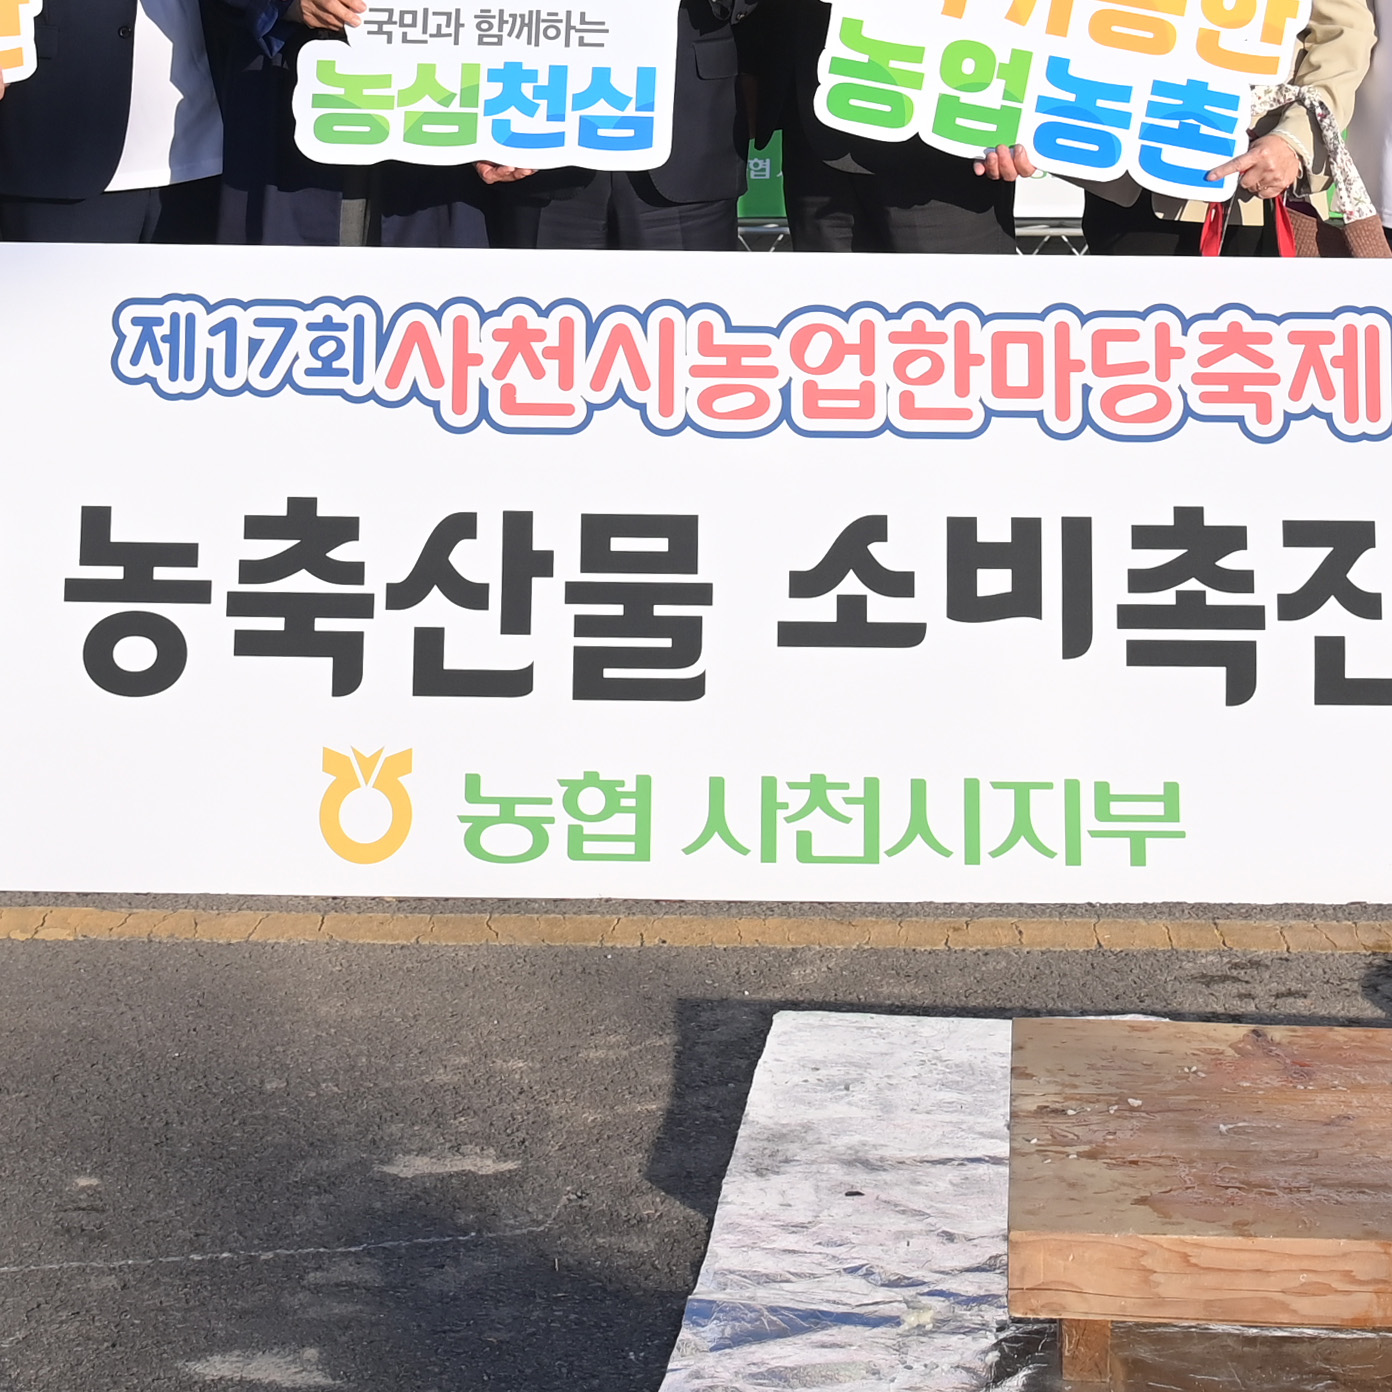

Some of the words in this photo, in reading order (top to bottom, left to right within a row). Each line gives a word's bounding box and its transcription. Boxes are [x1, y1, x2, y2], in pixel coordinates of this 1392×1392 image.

[363, 7, 465, 45] 국민과
[473, 8, 609, 48] 함께하는
[311, 59, 657, 152] 농심천심
[825, 16, 1242, 190] 농업농촌
[129, 311, 367, 386] 제17회
[383, 312, 1381, 427] 사천시농업한마당축제
[63, 496, 714, 702] 농축산물
[456, 770, 653, 865] 농협
[680, 772, 1187, 868] 사천시지부
